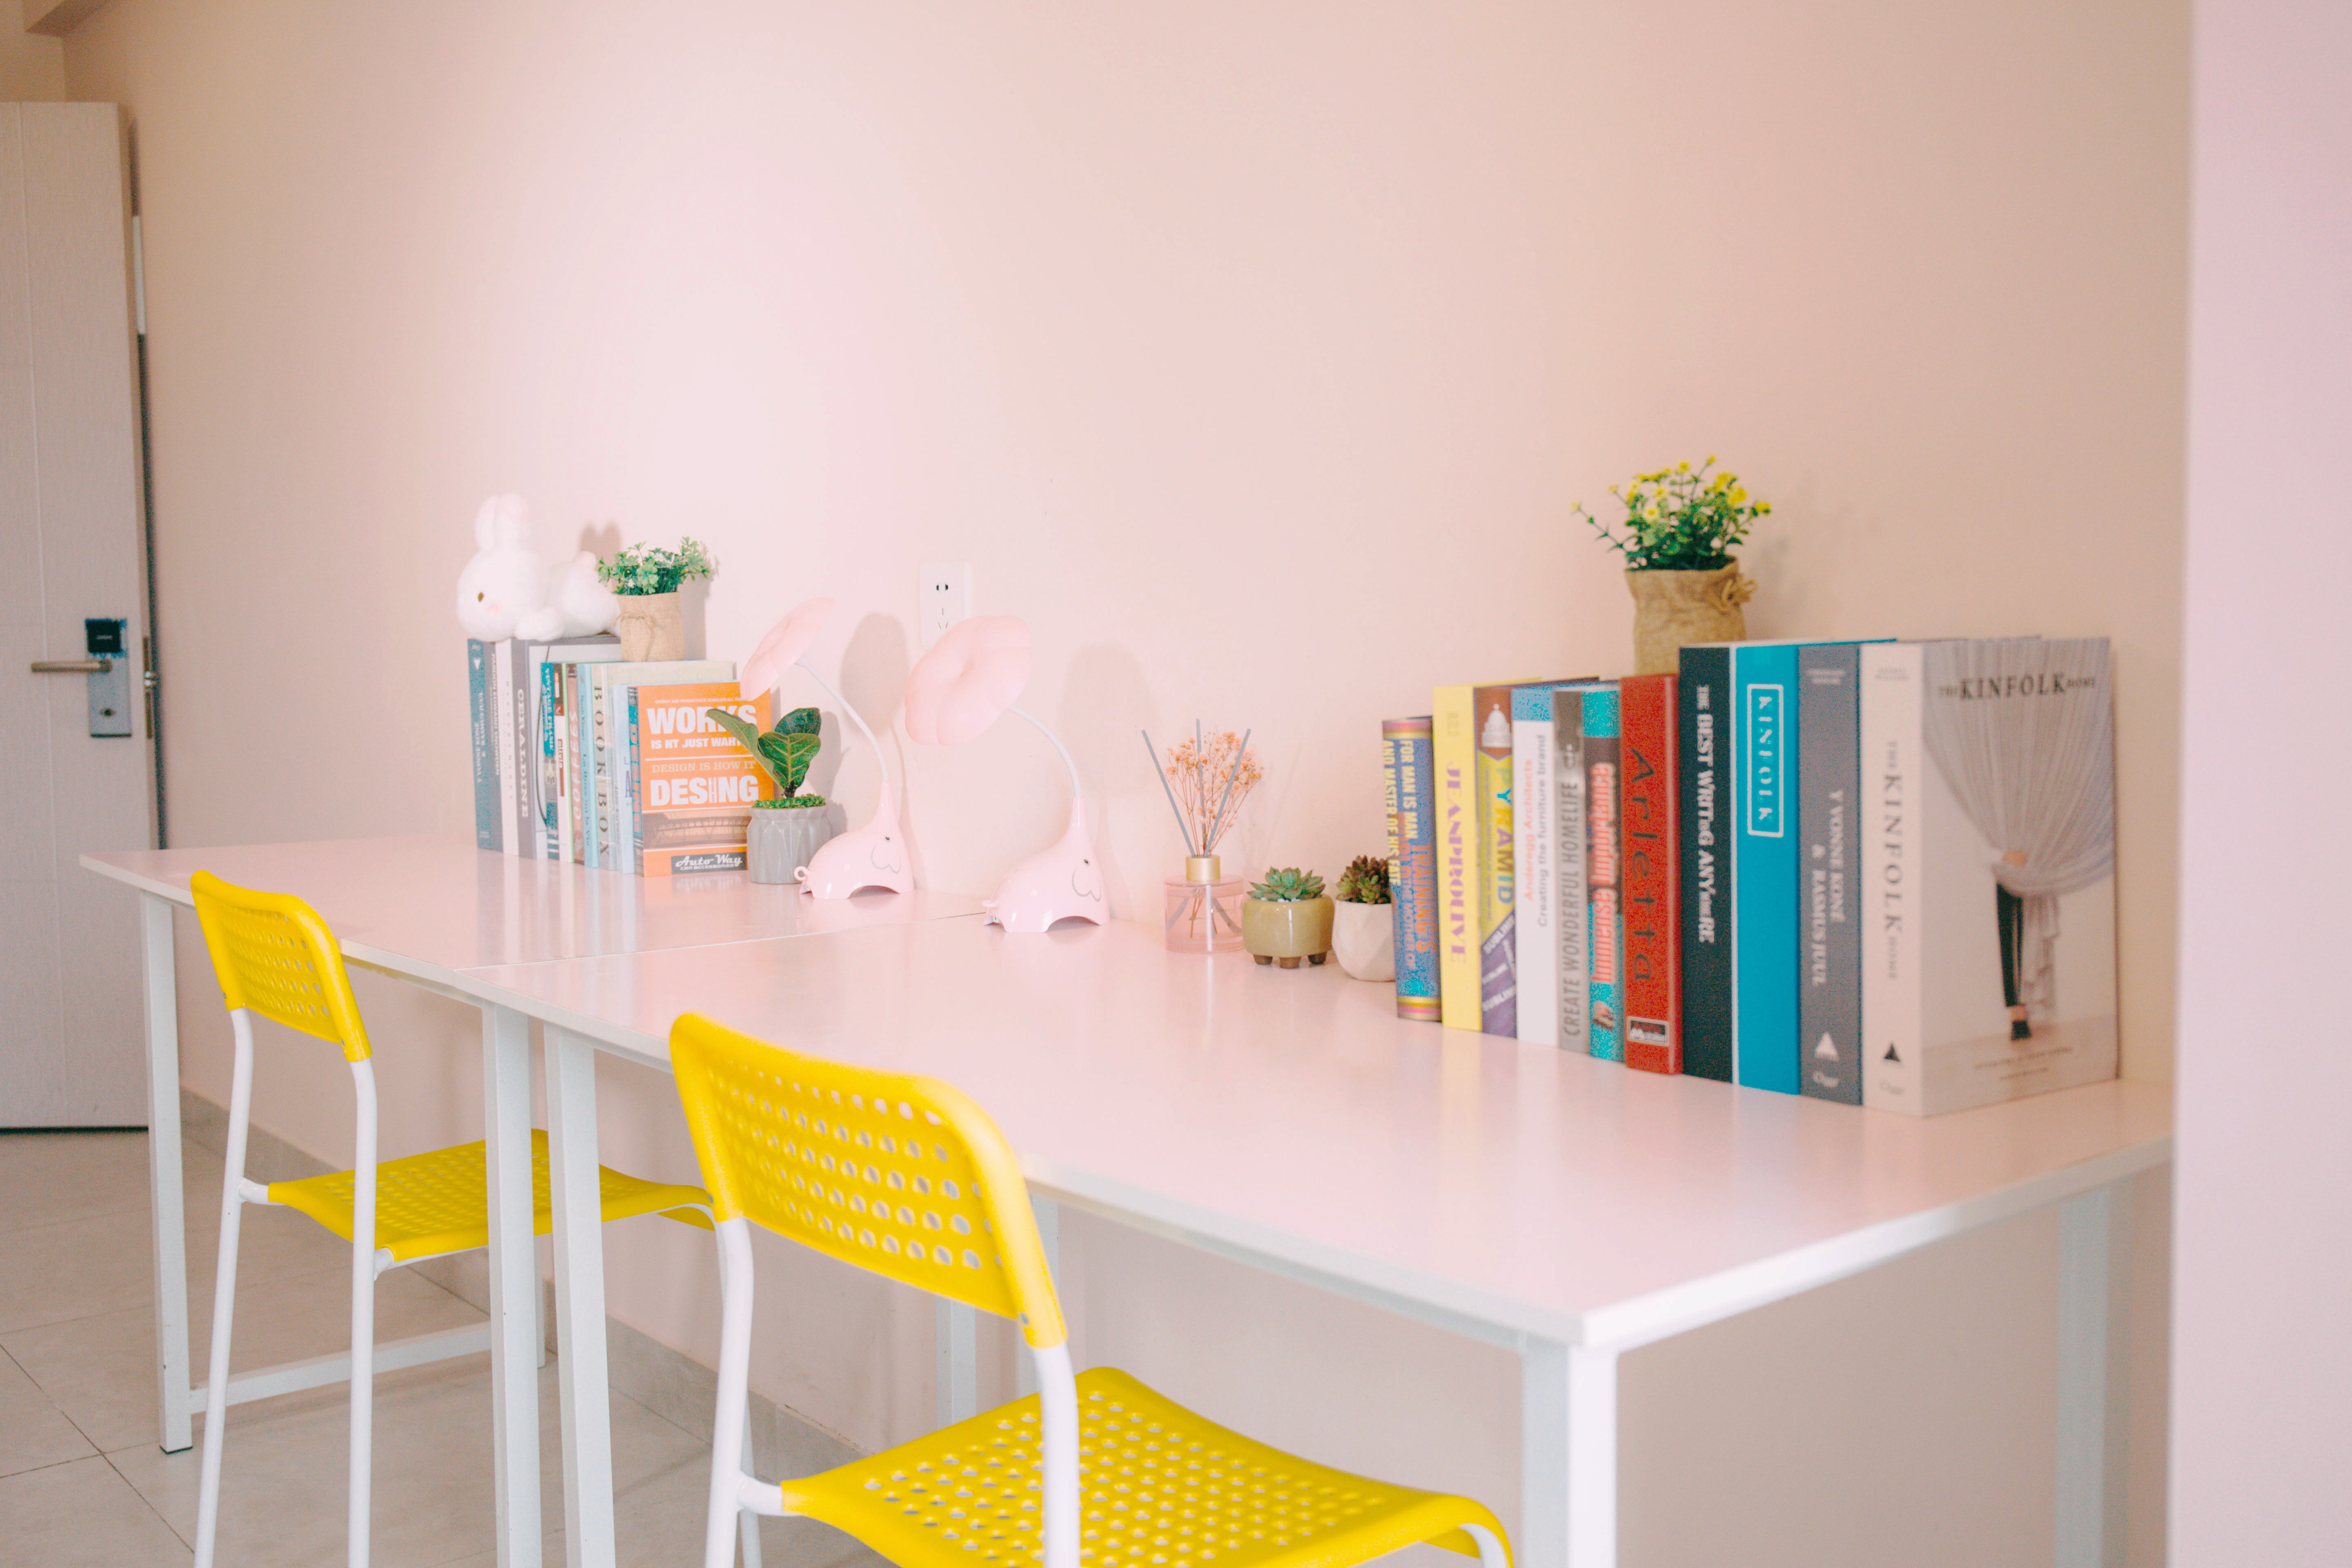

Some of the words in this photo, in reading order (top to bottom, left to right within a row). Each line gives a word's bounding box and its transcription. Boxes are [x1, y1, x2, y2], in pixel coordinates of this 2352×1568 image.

[1960, 671, 2065, 700] KINFOLK
[594, 685, 606, 774] BOOK
[651, 739, 662, 749] IS
[665, 739, 679, 749] NT
[682, 738, 708, 748] JUST
[1383, 739, 1395, 766] AND
[1399, 740, 1414, 763] FOR
[1697, 713, 1713, 766] BEST
[569, 710, 581, 820] COFFEES
[652, 763, 696, 773] DESIGN
[699, 762, 710, 771] IS
[713, 761, 740, 771] HOW
[742, 760, 756, 769] IT
[1402, 766, 1416, 793] MAN
[1537, 735, 1546, 775] brand
[1758, 696, 1773, 822] KINFOLK
[1385, 768, 1398, 815] MASTER
[1403, 796, 1417, 809] IS
[1523, 759, 1533, 829] Architects
[1538, 780, 1546, 839] furniture
[598, 793, 609, 855] BOX
[1388, 817, 1399, 834] OF
[1388, 835, 1400, 858] HIS
[1405, 811, 1419, 839] MAN
[1496, 767, 1514, 904] PYRAMID
[1561, 782, 1578, 864] HOMELIFE
[676, 855, 714, 867] Auto
[715, 854, 742, 866] Way
[1388, 859, 1401, 886] FATE
[1524, 833, 1536, 900] Anderegg
[1538, 841, 1547, 865] the
[1632, 748, 1658, 980] Arletta
[1884, 774, 1903, 932] KINFOLK
[1538, 868, 1549, 927] Creating
[1562, 869, 1580, 974] WONDERFUL
[1811, 869, 1826, 940] RASMUS
[1810, 942, 1826, 987] JUUL
[1564, 977, 1581, 1036] CREATE
